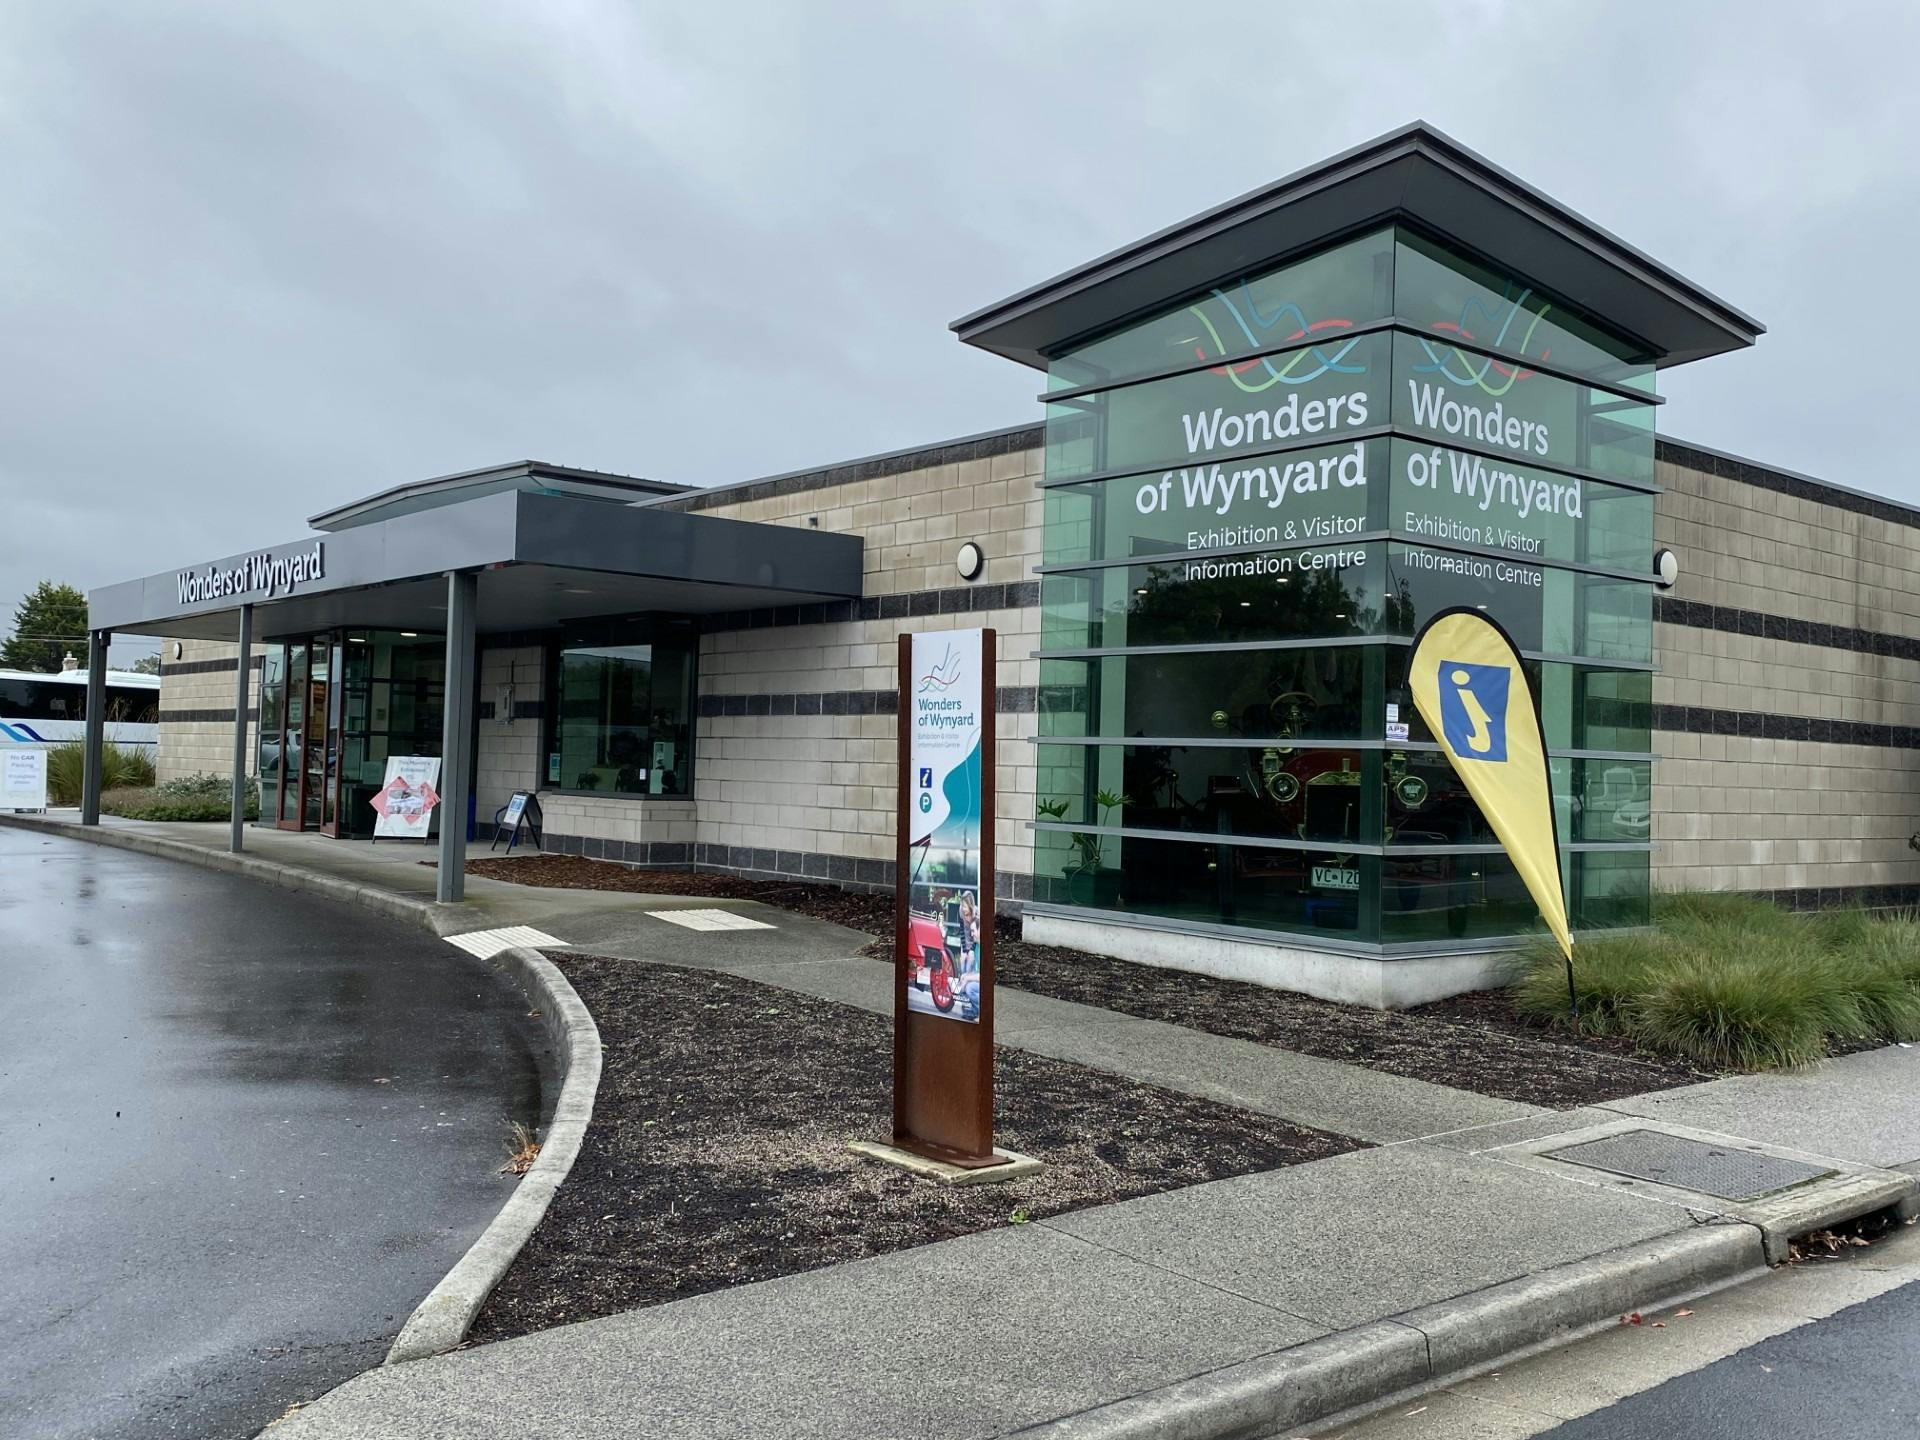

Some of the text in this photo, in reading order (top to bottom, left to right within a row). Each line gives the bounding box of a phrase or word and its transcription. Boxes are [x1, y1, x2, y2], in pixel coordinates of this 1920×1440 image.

[1182, 391, 1368, 453] Wonders
[1409, 379, 1549, 456] Wonders
[1136, 441, 1367, 515] of Wynyard
[1407, 447, 1582, 519] of Wynyard
[1187, 515, 1367, 550] Exhibition & Visitor
[1405, 511, 1541, 554] Exhibition & Visitor
[177, 542, 322, 604] Wonders of Wynyard
[1185, 550, 1367, 581] Information Centre
[1405, 548, 1542, 587] Information Centre
[918, 698, 962, 711] Wonders
[918, 712, 974, 729] of Wynyard
